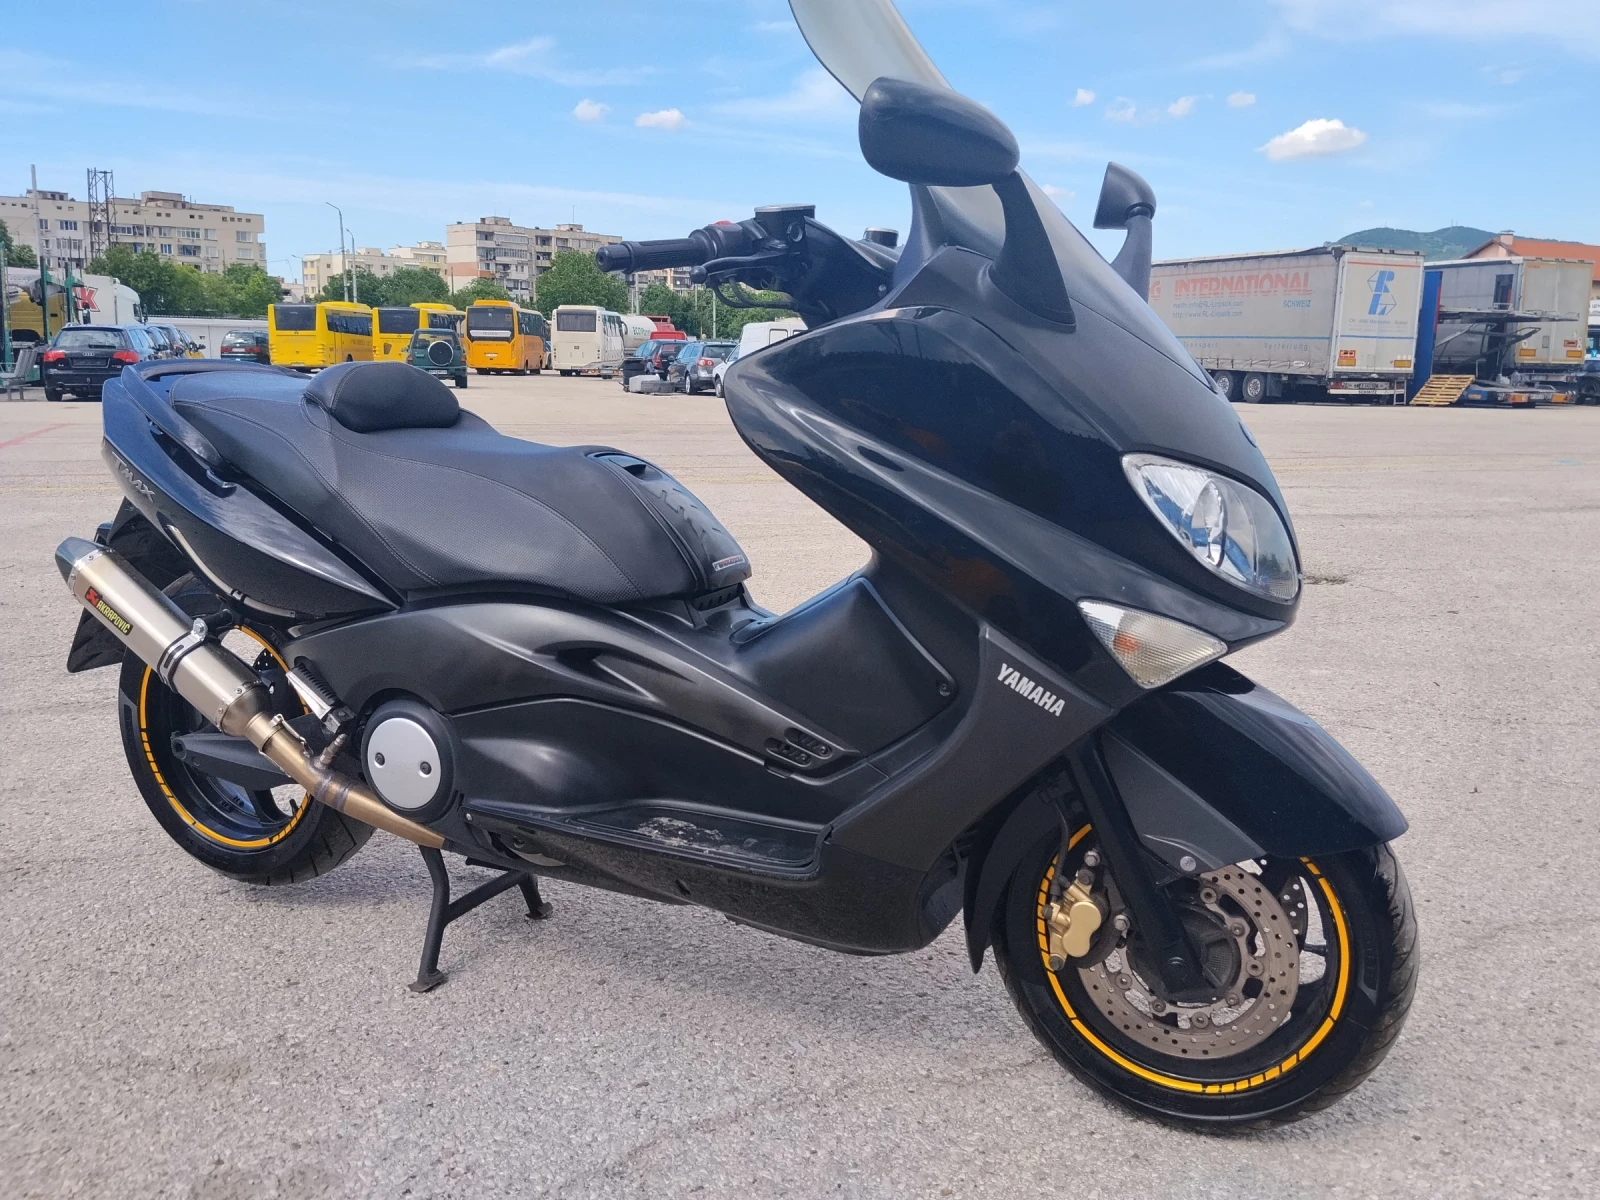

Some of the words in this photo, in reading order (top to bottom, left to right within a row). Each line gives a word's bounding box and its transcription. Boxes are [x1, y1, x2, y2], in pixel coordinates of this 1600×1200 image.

[1174, 272, 1312, 299] INTERNATIONAL
[1283, 300, 1312, 308] SCHWEIZ
[997, 663, 1065, 717] YAMAHA
